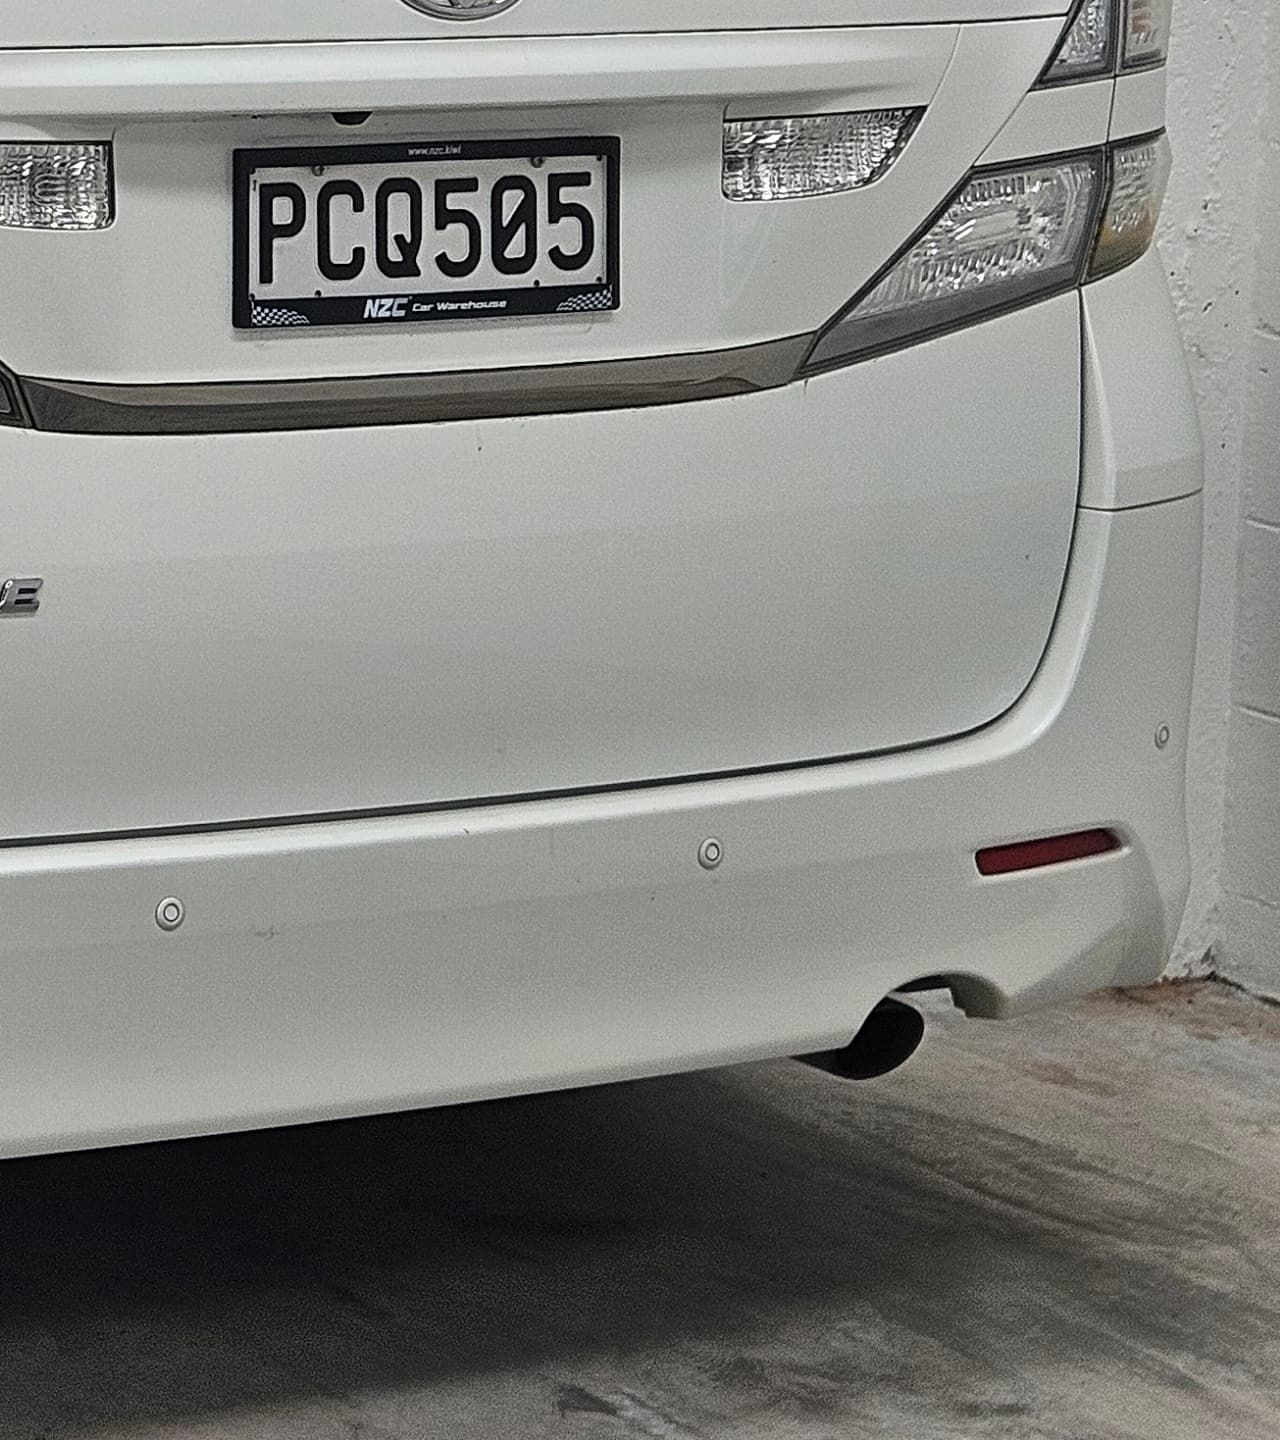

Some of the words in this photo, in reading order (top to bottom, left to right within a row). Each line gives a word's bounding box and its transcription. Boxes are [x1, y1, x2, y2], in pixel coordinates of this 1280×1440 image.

[257, 171, 596, 285] PCQ505
[363, 297, 409, 319] NZC
[412, 302, 434, 313] Car
[436, 300, 508, 312] Warehouse
